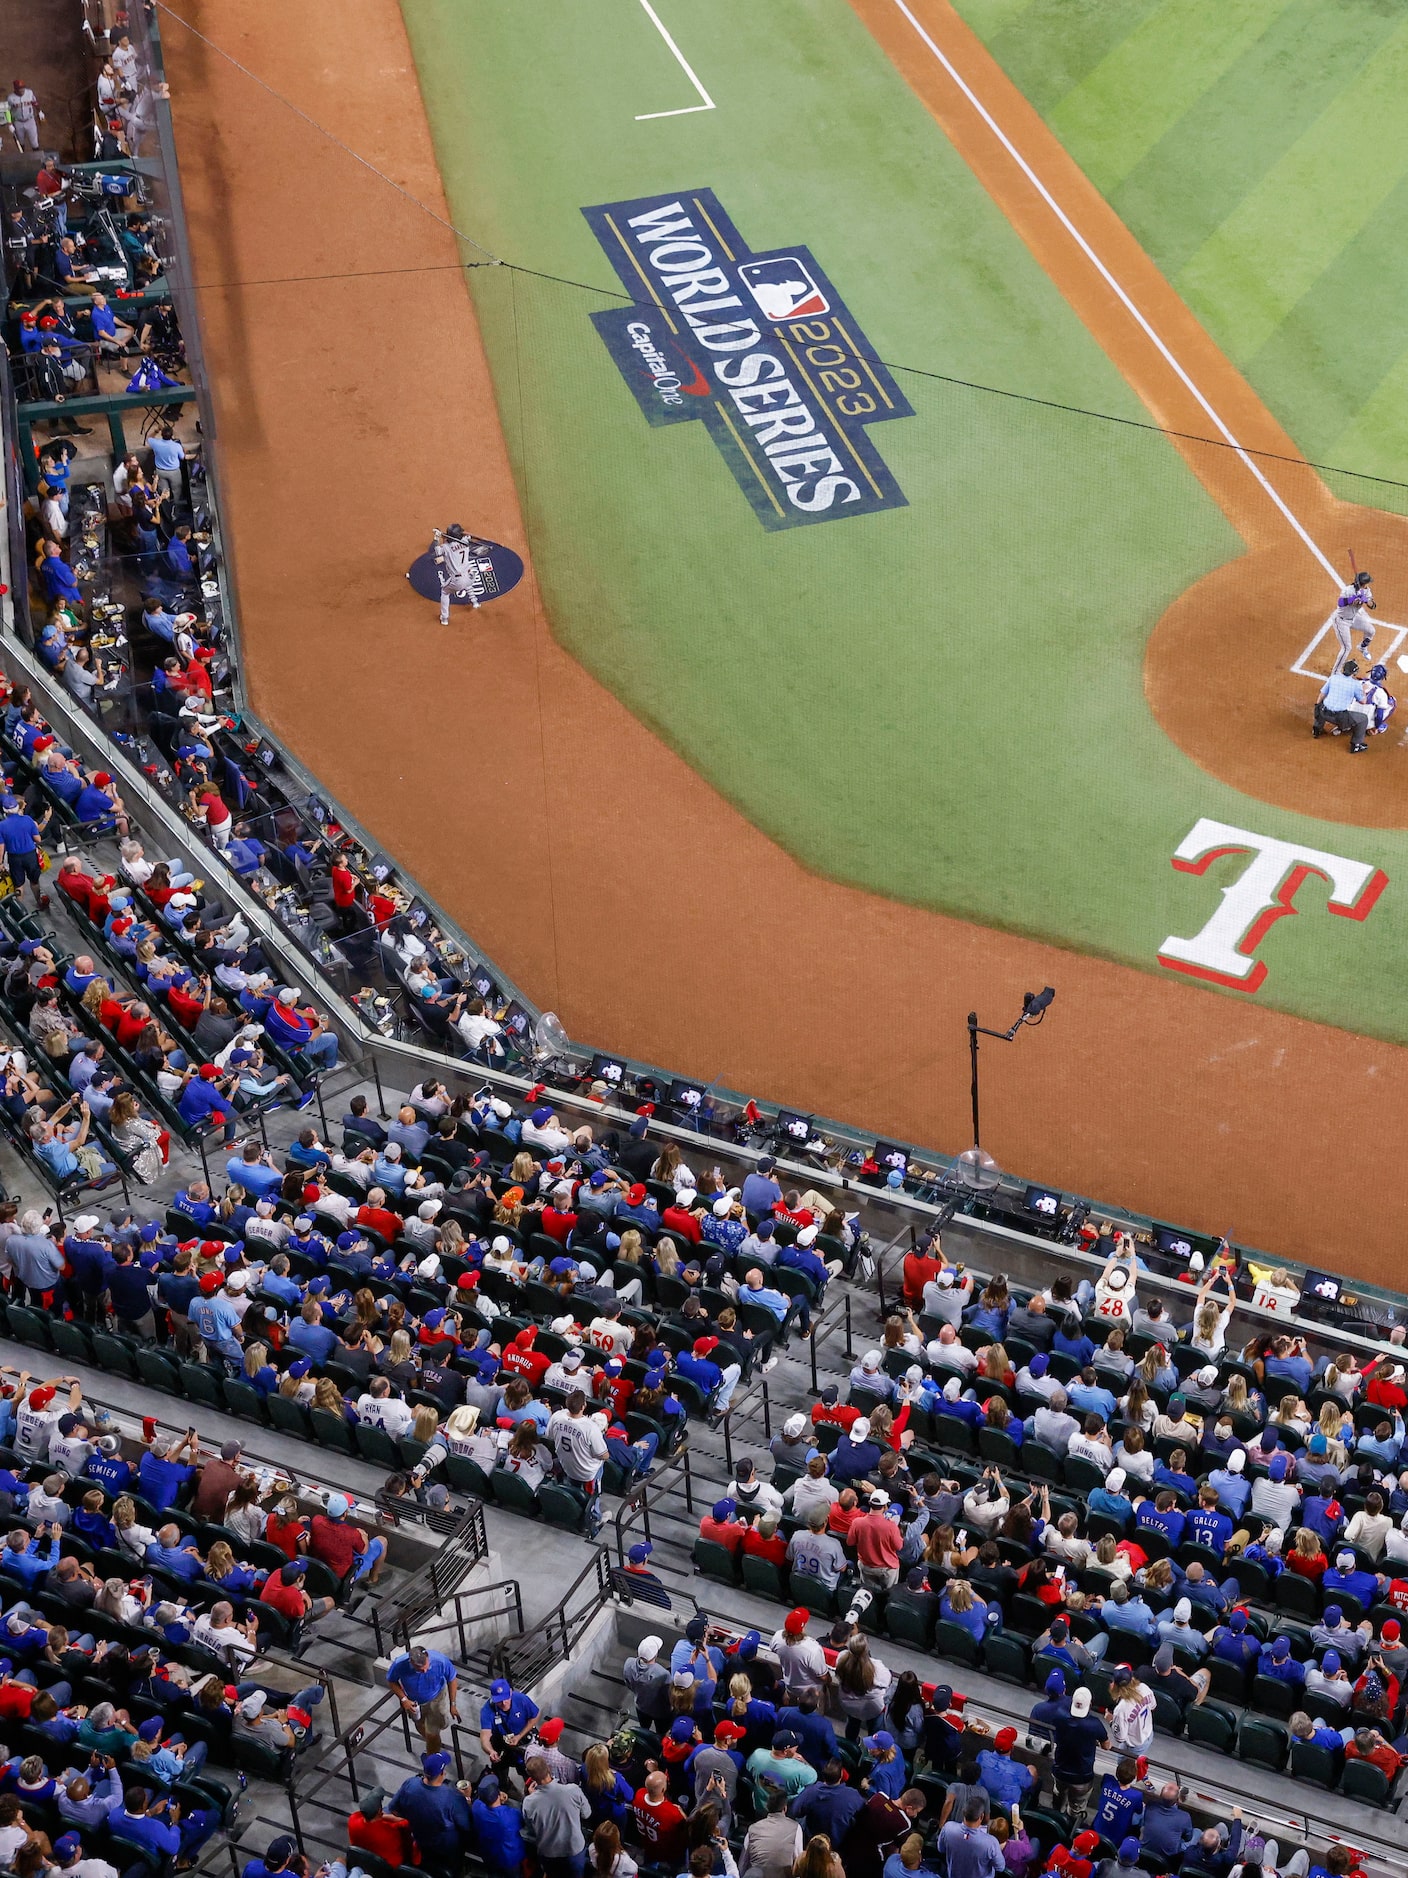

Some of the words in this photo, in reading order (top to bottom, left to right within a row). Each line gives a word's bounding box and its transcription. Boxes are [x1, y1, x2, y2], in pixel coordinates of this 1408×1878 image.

[627, 201, 762, 352] WORLD
[713, 352, 862, 512] SERIES
[788, 320, 877, 416] 2023
[458, 550, 466, 564] 7
[1156, 817, 1390, 994] T
[1099, 1297, 1123, 1317] 48
[203, 1318, 214, 1334] 6
[507, 1353, 533, 1370] ANDRUS
[423, 1369, 443, 1384] TEXAS
[364, 1403, 382, 1415] RYAN
[18, 1411, 44, 1429] SEAGER
[21, 1426, 33, 1444] 5
[555, 1422, 582, 1440] SEAGER
[54, 1444, 71, 1458] JUNG
[561, 1436, 572, 1453] 5
[1075, 1445, 1094, 1459] JUNG
[88, 1463, 118, 1480] SEMIEN
[510, 1459, 521, 1474] 7
[1141, 1515, 1169, 1533] BELTRE
[1193, 1516, 1218, 1528] GALLO
[1194, 1528, 1213, 1547] 13
[798, 1553, 820, 1574] 29
[1103, 1787, 1132, 1809] SEAGER
[1101, 1801, 1118, 1822] 5
[636, 1818, 659, 1842] 29
